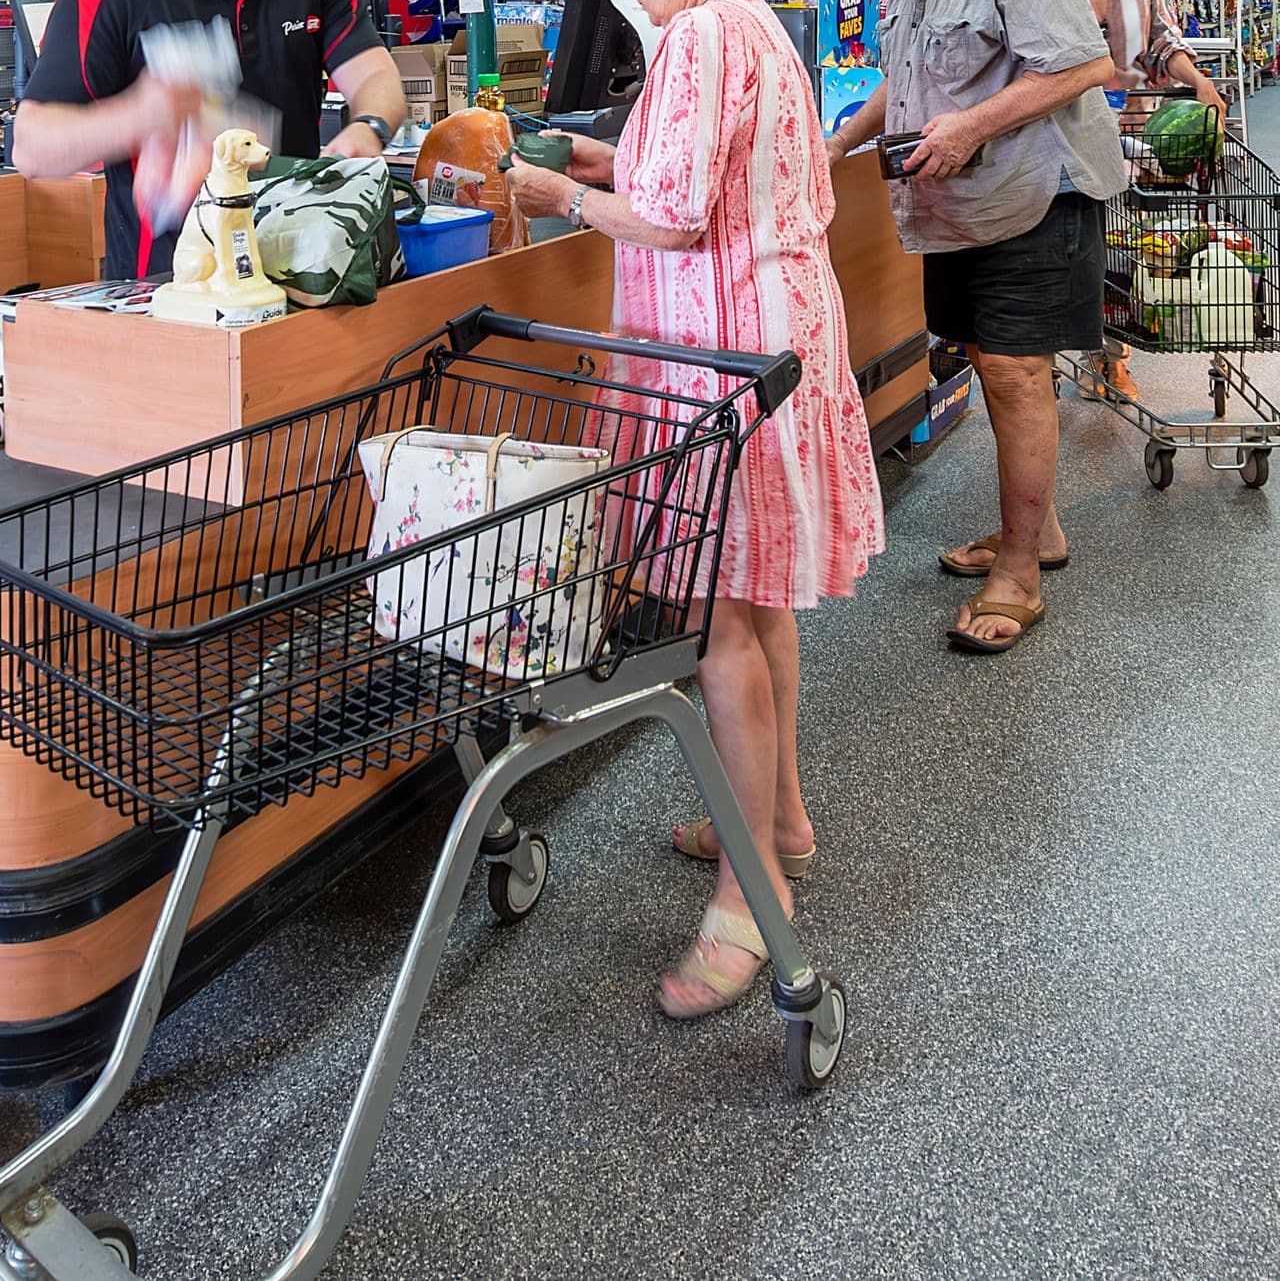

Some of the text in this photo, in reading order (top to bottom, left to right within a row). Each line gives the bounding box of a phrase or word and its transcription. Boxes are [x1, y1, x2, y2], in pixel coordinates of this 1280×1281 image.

[843, 6, 858, 20] YOUR
[839, 16, 863, 40] FAVES
[931, 398, 946, 421] GRAB
